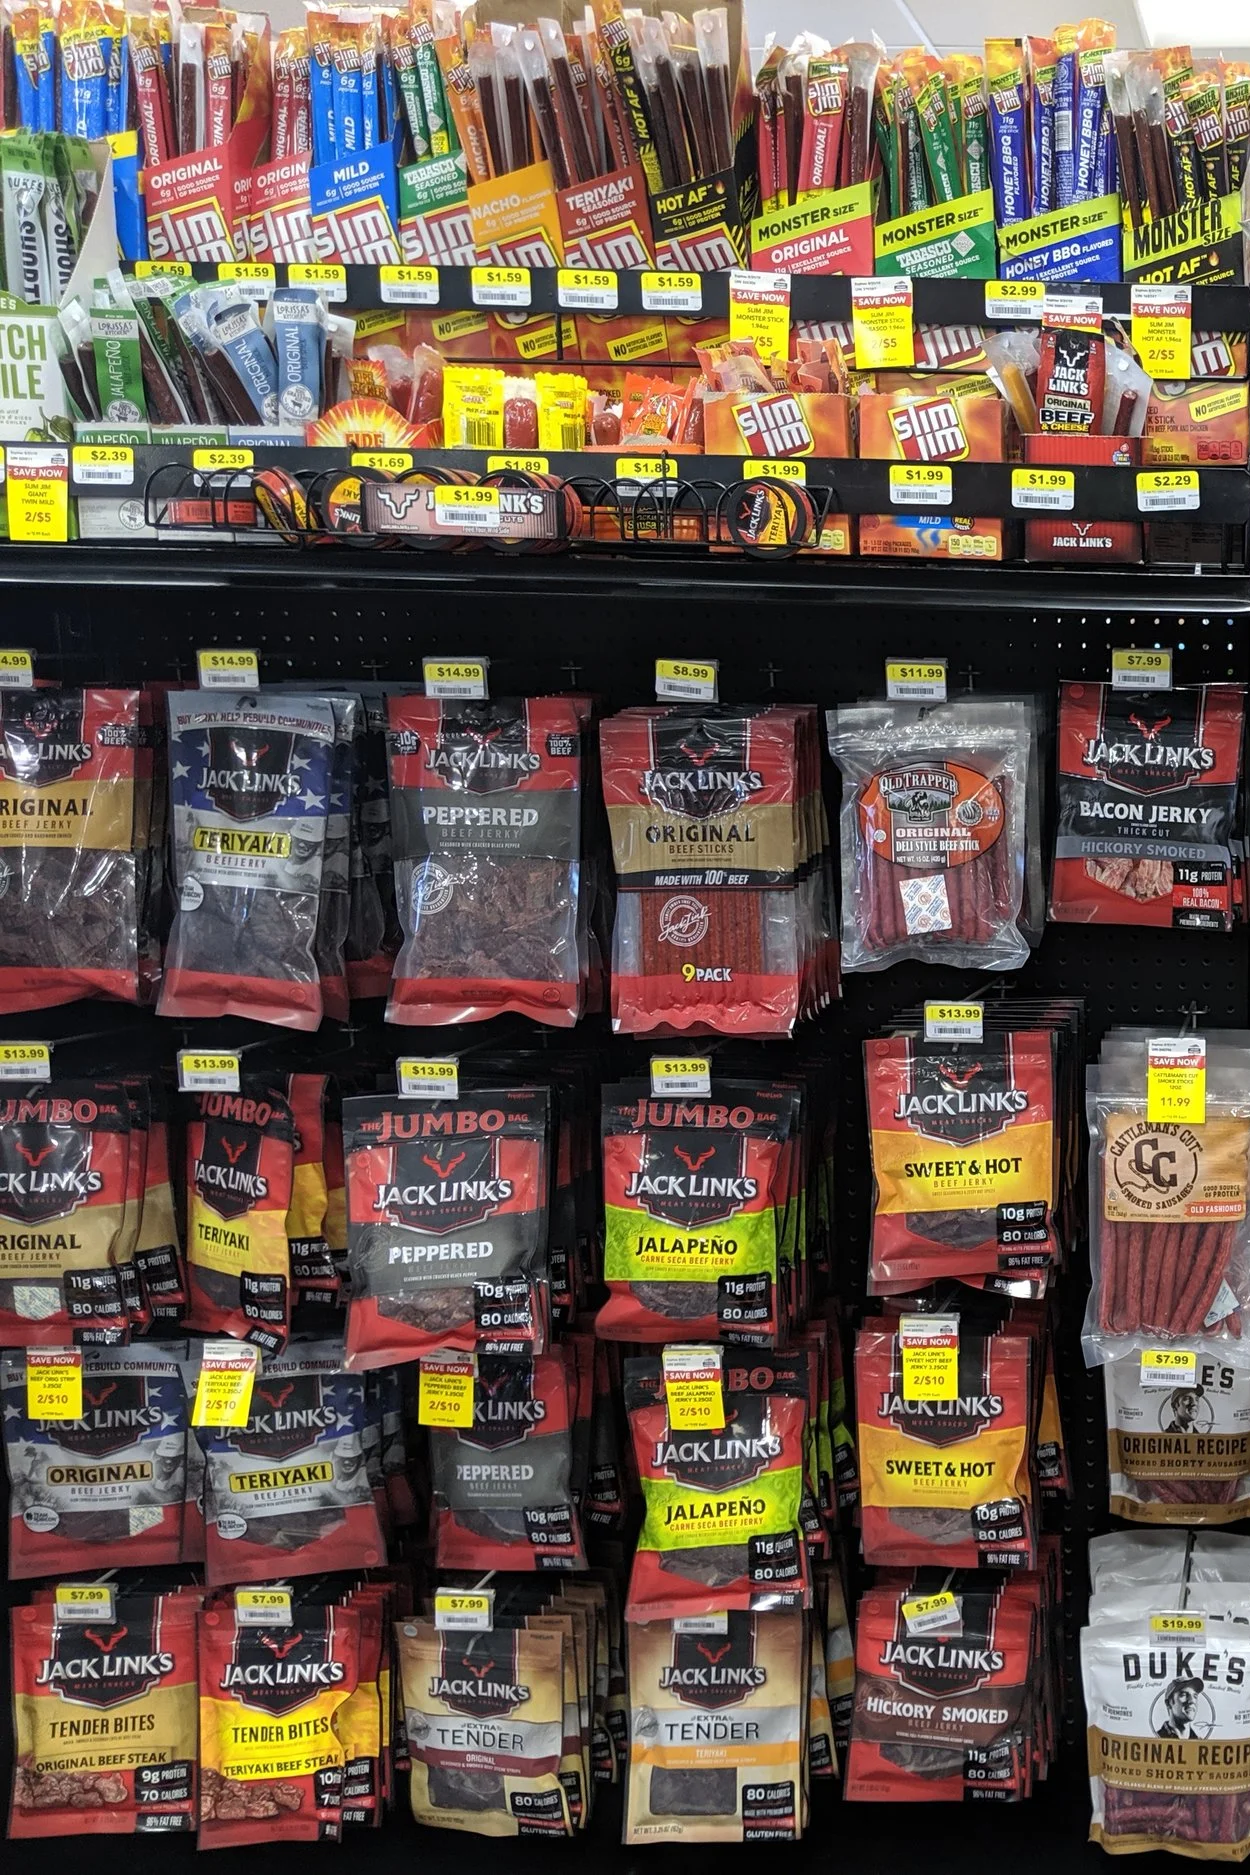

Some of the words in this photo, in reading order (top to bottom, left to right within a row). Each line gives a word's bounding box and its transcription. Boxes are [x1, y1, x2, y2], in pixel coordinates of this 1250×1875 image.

[813, 126, 827, 187] ORIGINAL
[1002, 135, 1012, 162] BBQ
[150, 158, 223, 189] ORIGINAL
[332, 162, 370, 182] MILD
[565, 179, 635, 211] TERIYAKI
[1003, 166, 1015, 216] HONEY
[657, 197, 681, 213] HOT
[687, 192, 706, 207] AF
[758, 210, 827, 239] MONSTER
[832, 204, 854, 217] SIZE
[882, 221, 952, 247] MONSTER
[958, 210, 980, 223] SIZE
[1134, 202, 1222, 259] MONSTER
[1005, 221, 1076, 250] MONSTER
[1082, 214, 1106, 227] SIZE
[1202, 228, 1231, 247] SIZE
[771, 234, 848, 263] ORIGINAL
[897, 240, 952, 266] TABASCO
[905, 256, 954, 276] SEASONED
[1005, 256, 1049, 279] HONEY
[1053, 247, 1080, 266] BBQ
[1081, 238, 1114, 254] FLAVORED
[234, 268, 268, 277] $1.59
[574, 274, 608, 284] $1.59
[1002, 286, 1037, 296] $2.99
[1138, 306, 1160, 314] SAVE
[1163, 306, 1186, 314] NOW
[285, 326, 300, 391] ORIGINAL
[1148, 349, 1175, 361] 2/$5
[1052, 366, 1088, 383] JACK
[1049, 380, 1089, 394] LINK'S
[1046, 399, 1088, 410] ORIGINAL
[1040, 410, 1092, 423] BEEF
[1053, 422, 1089, 432] CHEESE
[92, 450, 128, 460] $2.39
[368, 457, 404, 468] $1.69
[906, 470, 944, 481] $1.99
[1154, 476, 1191, 488] $2.29
[25, 511, 52, 522] 2/$5
[1053, 535, 1077, 547] JACK
[1078, 535, 1112, 548] LINK'S
[212, 656, 254, 666] $14.99
[1127, 655, 1162, 666] $7.99
[673, 667, 709, 678] $8.99
[900, 668, 943, 680] $11.99
[425, 749, 476, 771] JACK
[481, 751, 540, 771] LINK'S
[879, 774, 901, 793] OLD
[903, 773, 958, 796] TRAPPER
[423, 806, 538, 827] PEPPERED
[1079, 801, 1144, 822] BACON
[1150, 802, 1212, 824] JERKY
[442, 828, 471, 839] BEEF
[486, 828, 521, 839] JERKY
[646, 824, 755, 843] ORIGINAL
[896, 826, 972, 839] ORIGINAL
[1118, 826, 1143, 837] THICK
[1147, 827, 1171, 837] CUT
[669, 844, 694, 854] BEEF
[698, 843, 734, 854] STICKS
[1082, 841, 1141, 857] HICKORY
[1146, 844, 1207, 860] SMOKED
[1160, 1096, 1190, 1108] 11.99
[376, 1110, 505, 1142] JUMBO
[905, 1162, 965, 1178] SWEET
[968, 1160, 982, 1175] &
[985, 1157, 1022, 1176] HOT
[376, 1185, 431, 1208] JACK
[438, 1180, 511, 1201] LINK'S
[1191, 1203, 1207, 1214] OLD
[1209, 1203, 1242, 1214] FASHIONED
[388, 1242, 493, 1264] PEPPERED
[38, 1394, 68, 1405] 2/$10
[1123, 1438, 1189, 1455] ORIGINAL
[1197, 1438, 1247, 1453] RECIPE
[51, 1464, 151, 1483] ORIGINAL
[235, 1465, 328, 1487] TERIYAKI
[71, 1590, 103, 1601] $7.99
[1162, 1620, 1203, 1630] $19.99
[867, 1696, 936, 1721] HICKORY
[942, 1707, 1008, 1724] SMOKED
[49, 1719, 107, 1738] TENDER
[112, 1715, 155, 1733] BITES
[437, 1728, 525, 1752] TENDER
